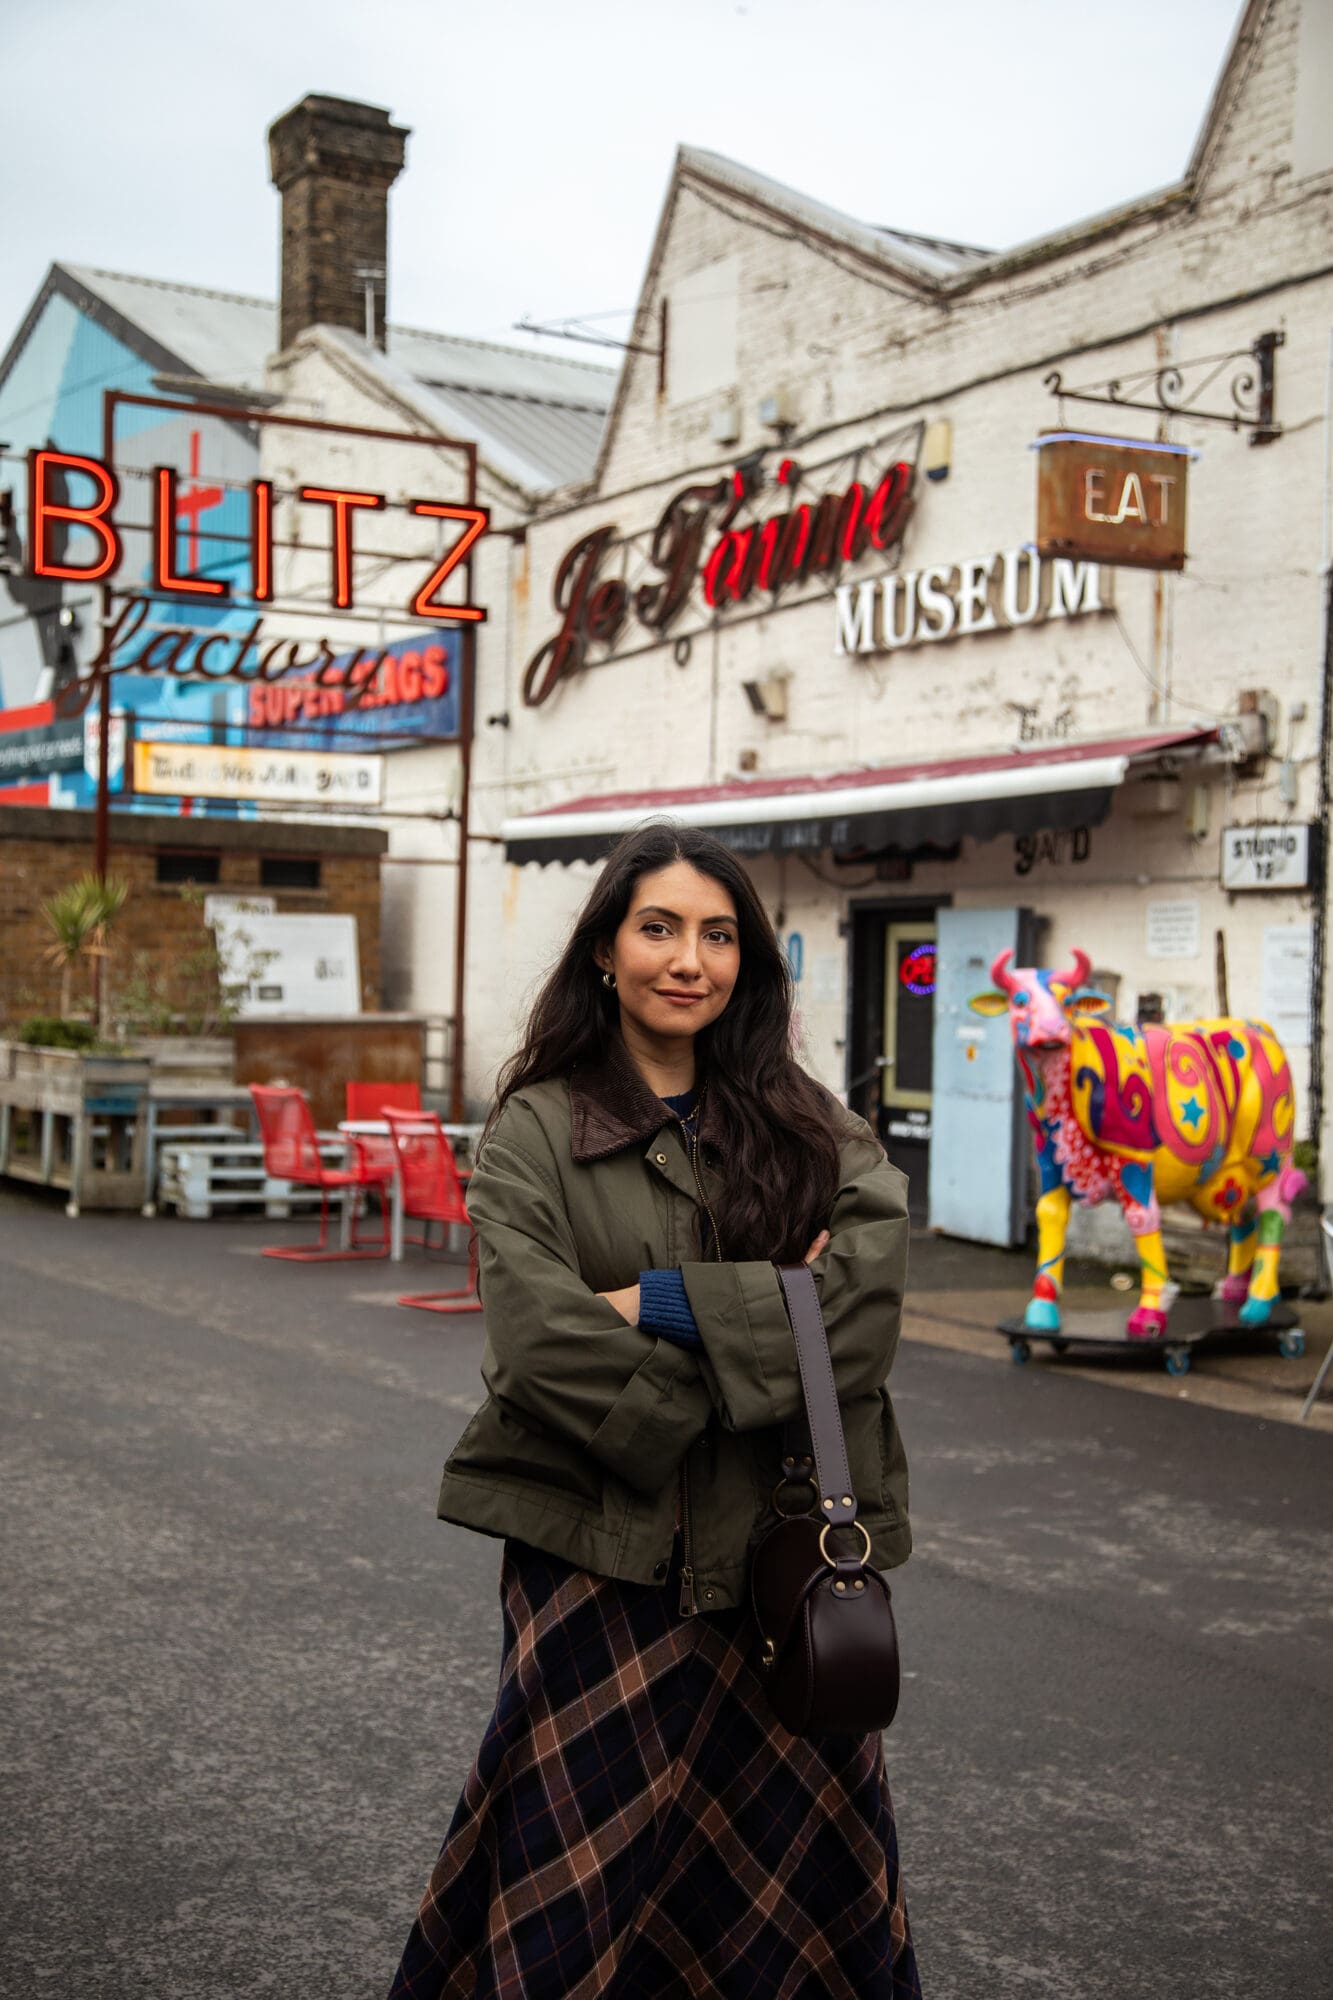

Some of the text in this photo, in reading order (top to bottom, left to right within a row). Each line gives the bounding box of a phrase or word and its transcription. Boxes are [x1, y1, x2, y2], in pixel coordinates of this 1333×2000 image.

[28, 449, 490, 622] BLITZ
[1084, 468, 1178, 527] EAT
[834, 547, 1102, 656] MUSEUM
